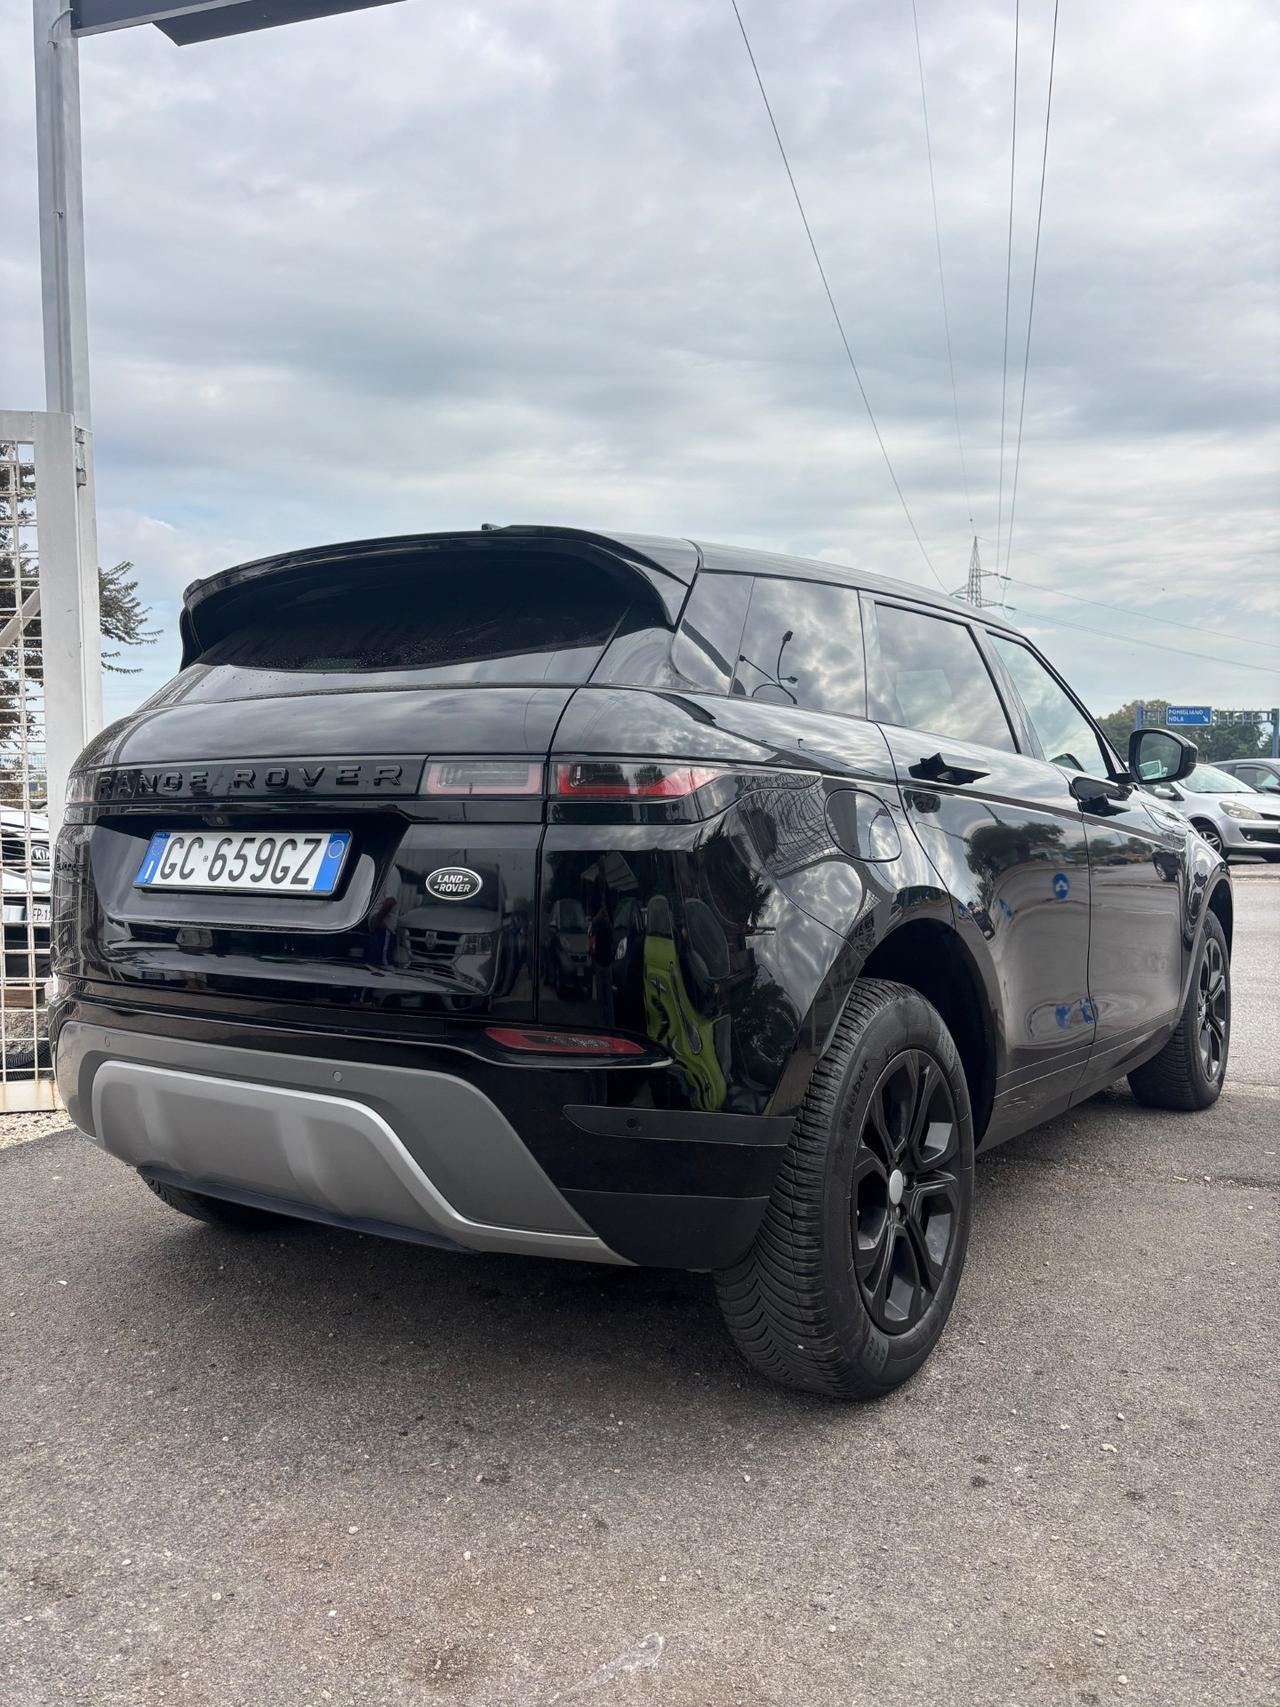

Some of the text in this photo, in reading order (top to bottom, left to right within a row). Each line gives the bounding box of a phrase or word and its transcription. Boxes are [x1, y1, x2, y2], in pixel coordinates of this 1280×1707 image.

[100, 765, 402, 794] RANGE ROVER
[437, 875, 463, 883] LAND
[438, 884, 471, 892] ROVER
